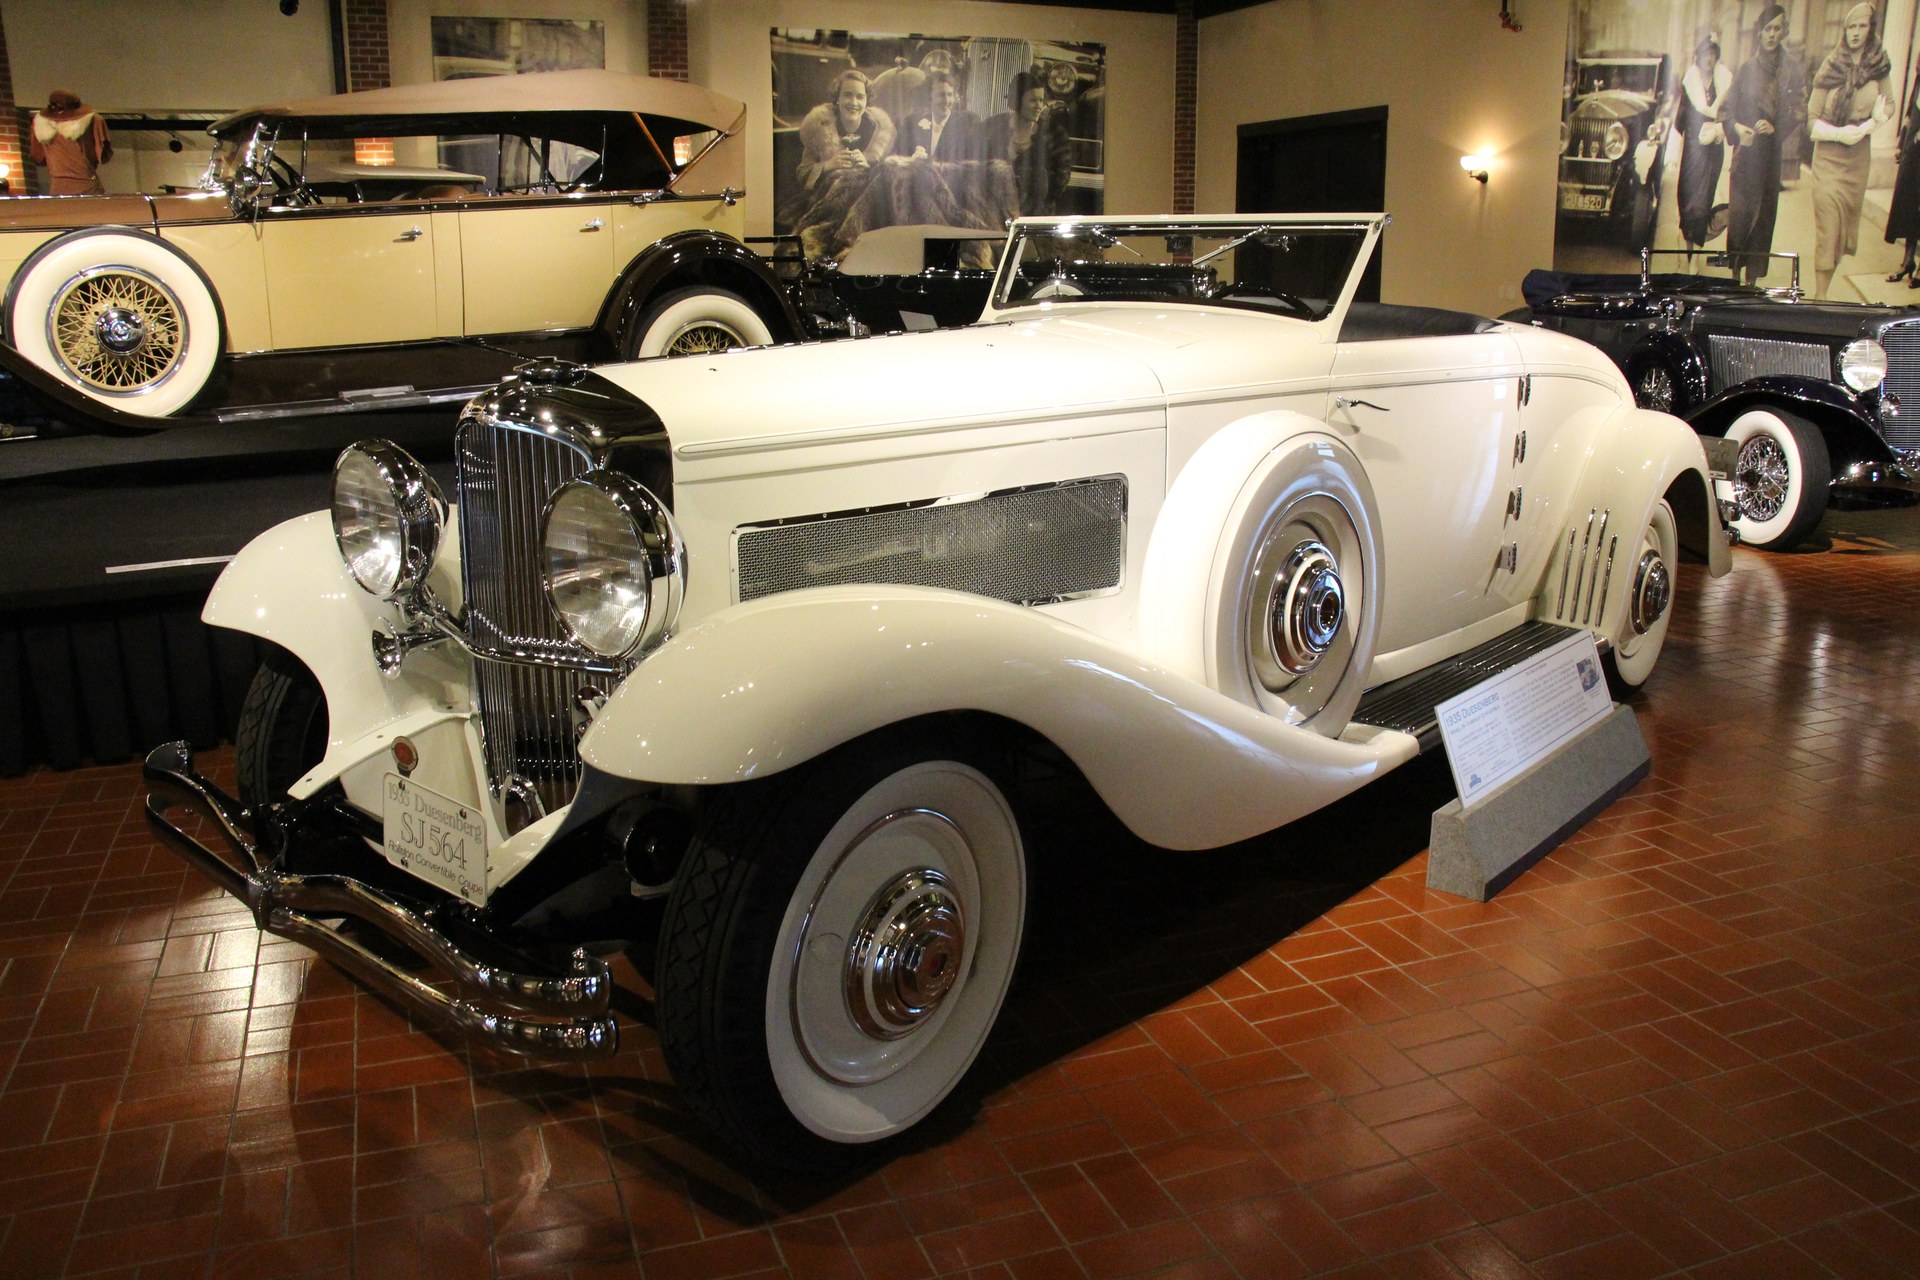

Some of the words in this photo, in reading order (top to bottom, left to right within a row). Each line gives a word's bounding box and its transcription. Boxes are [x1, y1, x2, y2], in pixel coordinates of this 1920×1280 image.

[1445, 711, 1462, 727] 1935
[401, 812, 425, 848] SJ
[429, 825, 467, 870] 564
[415, 794, 482, 844] Duesenberg
[415, 853, 456, 881] Convertible
[458, 875, 483, 895] Coupe
